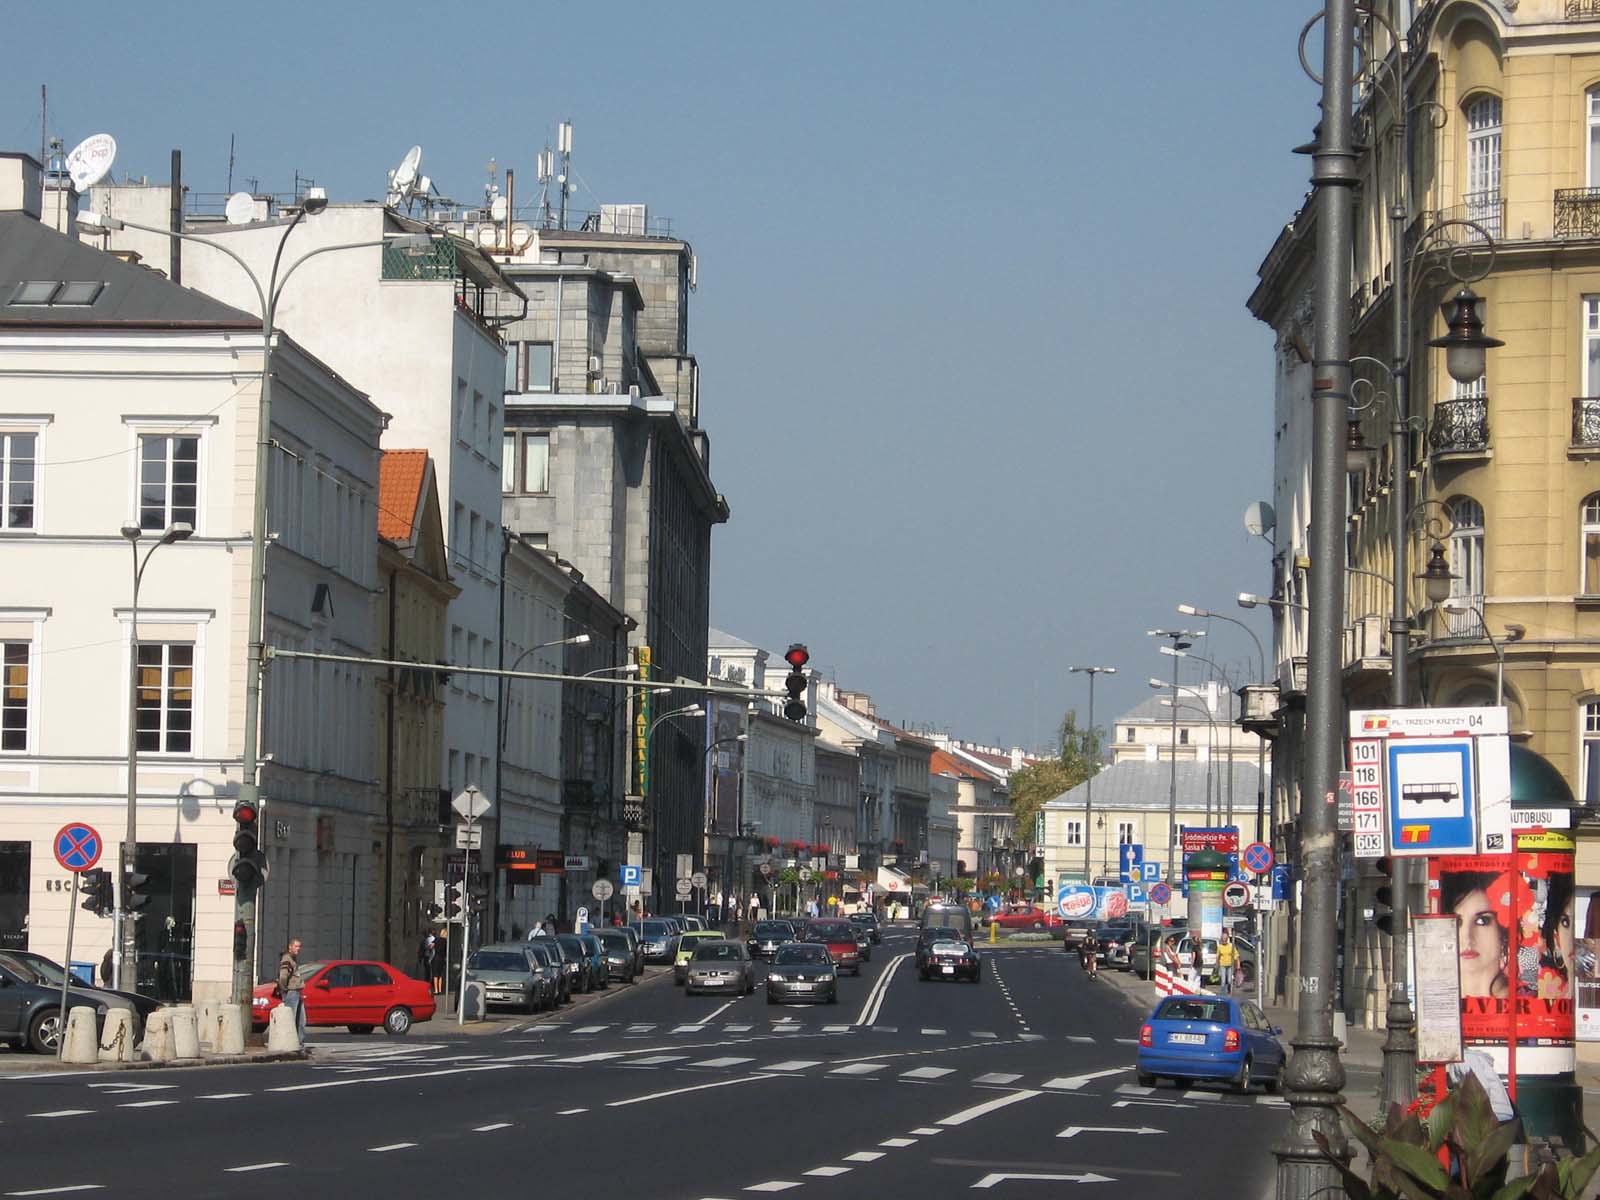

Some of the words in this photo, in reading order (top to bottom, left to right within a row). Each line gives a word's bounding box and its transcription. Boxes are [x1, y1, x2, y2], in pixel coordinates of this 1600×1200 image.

[1469, 714, 1483, 727] 04
[1354, 745, 1376, 760] 101
[1356, 767, 1375, 782] 118
[1356, 791, 1378, 806] 166
[1357, 814, 1378, 828] 171
[1357, 835, 1381, 849] 603
